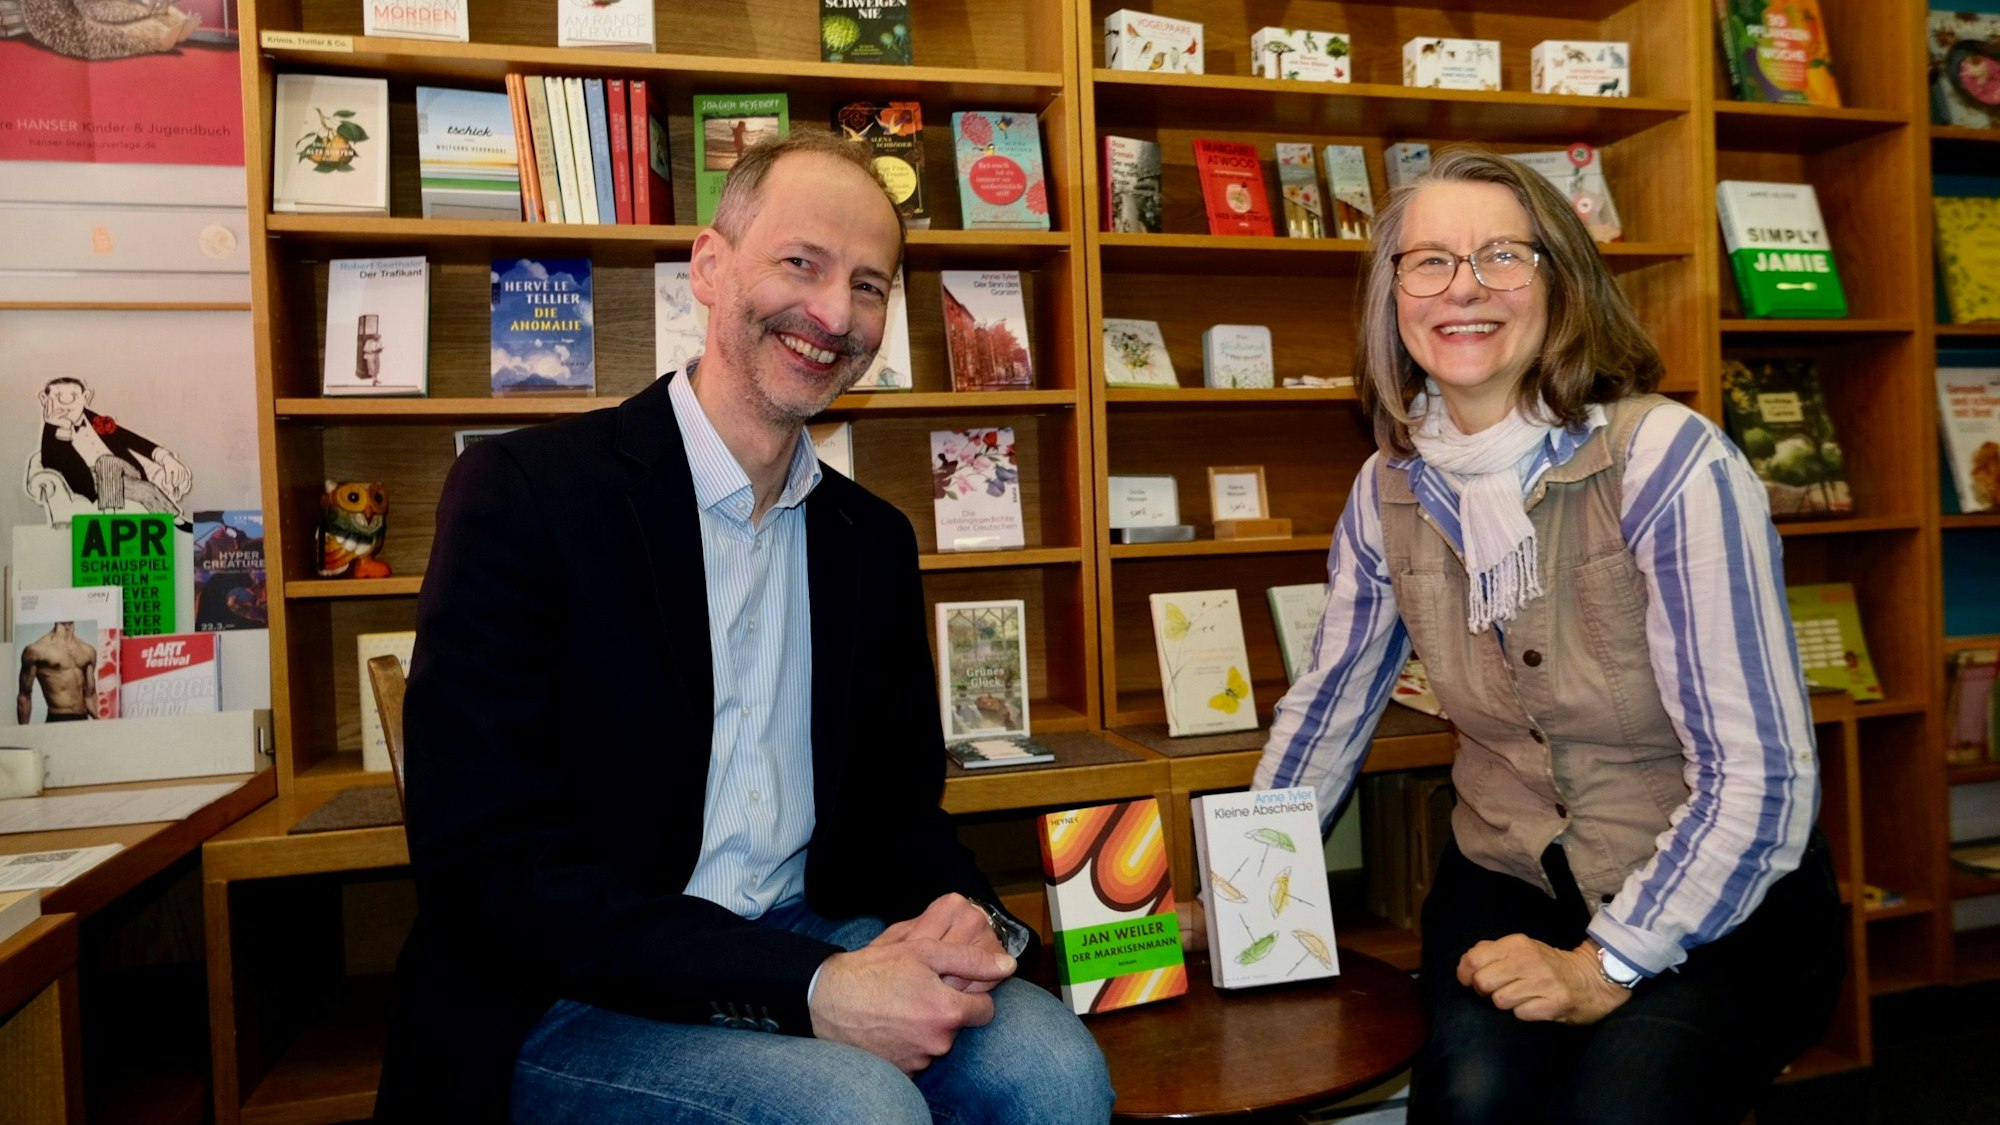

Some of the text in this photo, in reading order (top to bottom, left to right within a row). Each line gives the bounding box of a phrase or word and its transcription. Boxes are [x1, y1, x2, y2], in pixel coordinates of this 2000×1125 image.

[374, 6, 456, 22] MORDEN
[858, 8, 882, 19] NIE
[267, 36, 295, 45] Krimis,
[298, 38, 324, 46] Thriller
[702, 101, 736, 110] JOACHIM
[17, 119, 78, 131] HANSER
[82, 123, 127, 133] Kinder-
[135, 124, 143, 133] &
[149, 124, 231, 137] Jugendbuch
[447, 125, 494, 137] tschick
[1208, 156, 1255, 169] ATWOOD
[1747, 228, 1819, 244] SIMPLY
[340, 261, 422, 271] Robert Seethaler
[1753, 252, 1830, 273] JAMIE
[360, 269, 422, 279] Der Trafikant
[505, 279, 569, 291] HERVÉ LE
[527, 293, 580, 305] TELLIER
[534, 307, 558, 319] DIE
[510, 320, 582, 331] ANOMALIE
[81, 519, 168, 557] APR
[219, 550, 260, 560] HYPER
[81, 559, 169, 573] SCHAUSPIEL
[102, 573, 149, 586] KOELN
[146, 654, 191, 669] festival
[966, 668, 1005, 678] Grünes
[970, 677, 1001, 688] Glück
[1255, 790, 1313, 804] Anne Tyler
[1214, 800, 1314, 819] Kleine Abschiede
[1050, 818, 1074, 827] HEYNE
[1082, 921, 1165, 947] JAN WEILER
[1072, 936, 1177, 963] DER MARKISENMANN
